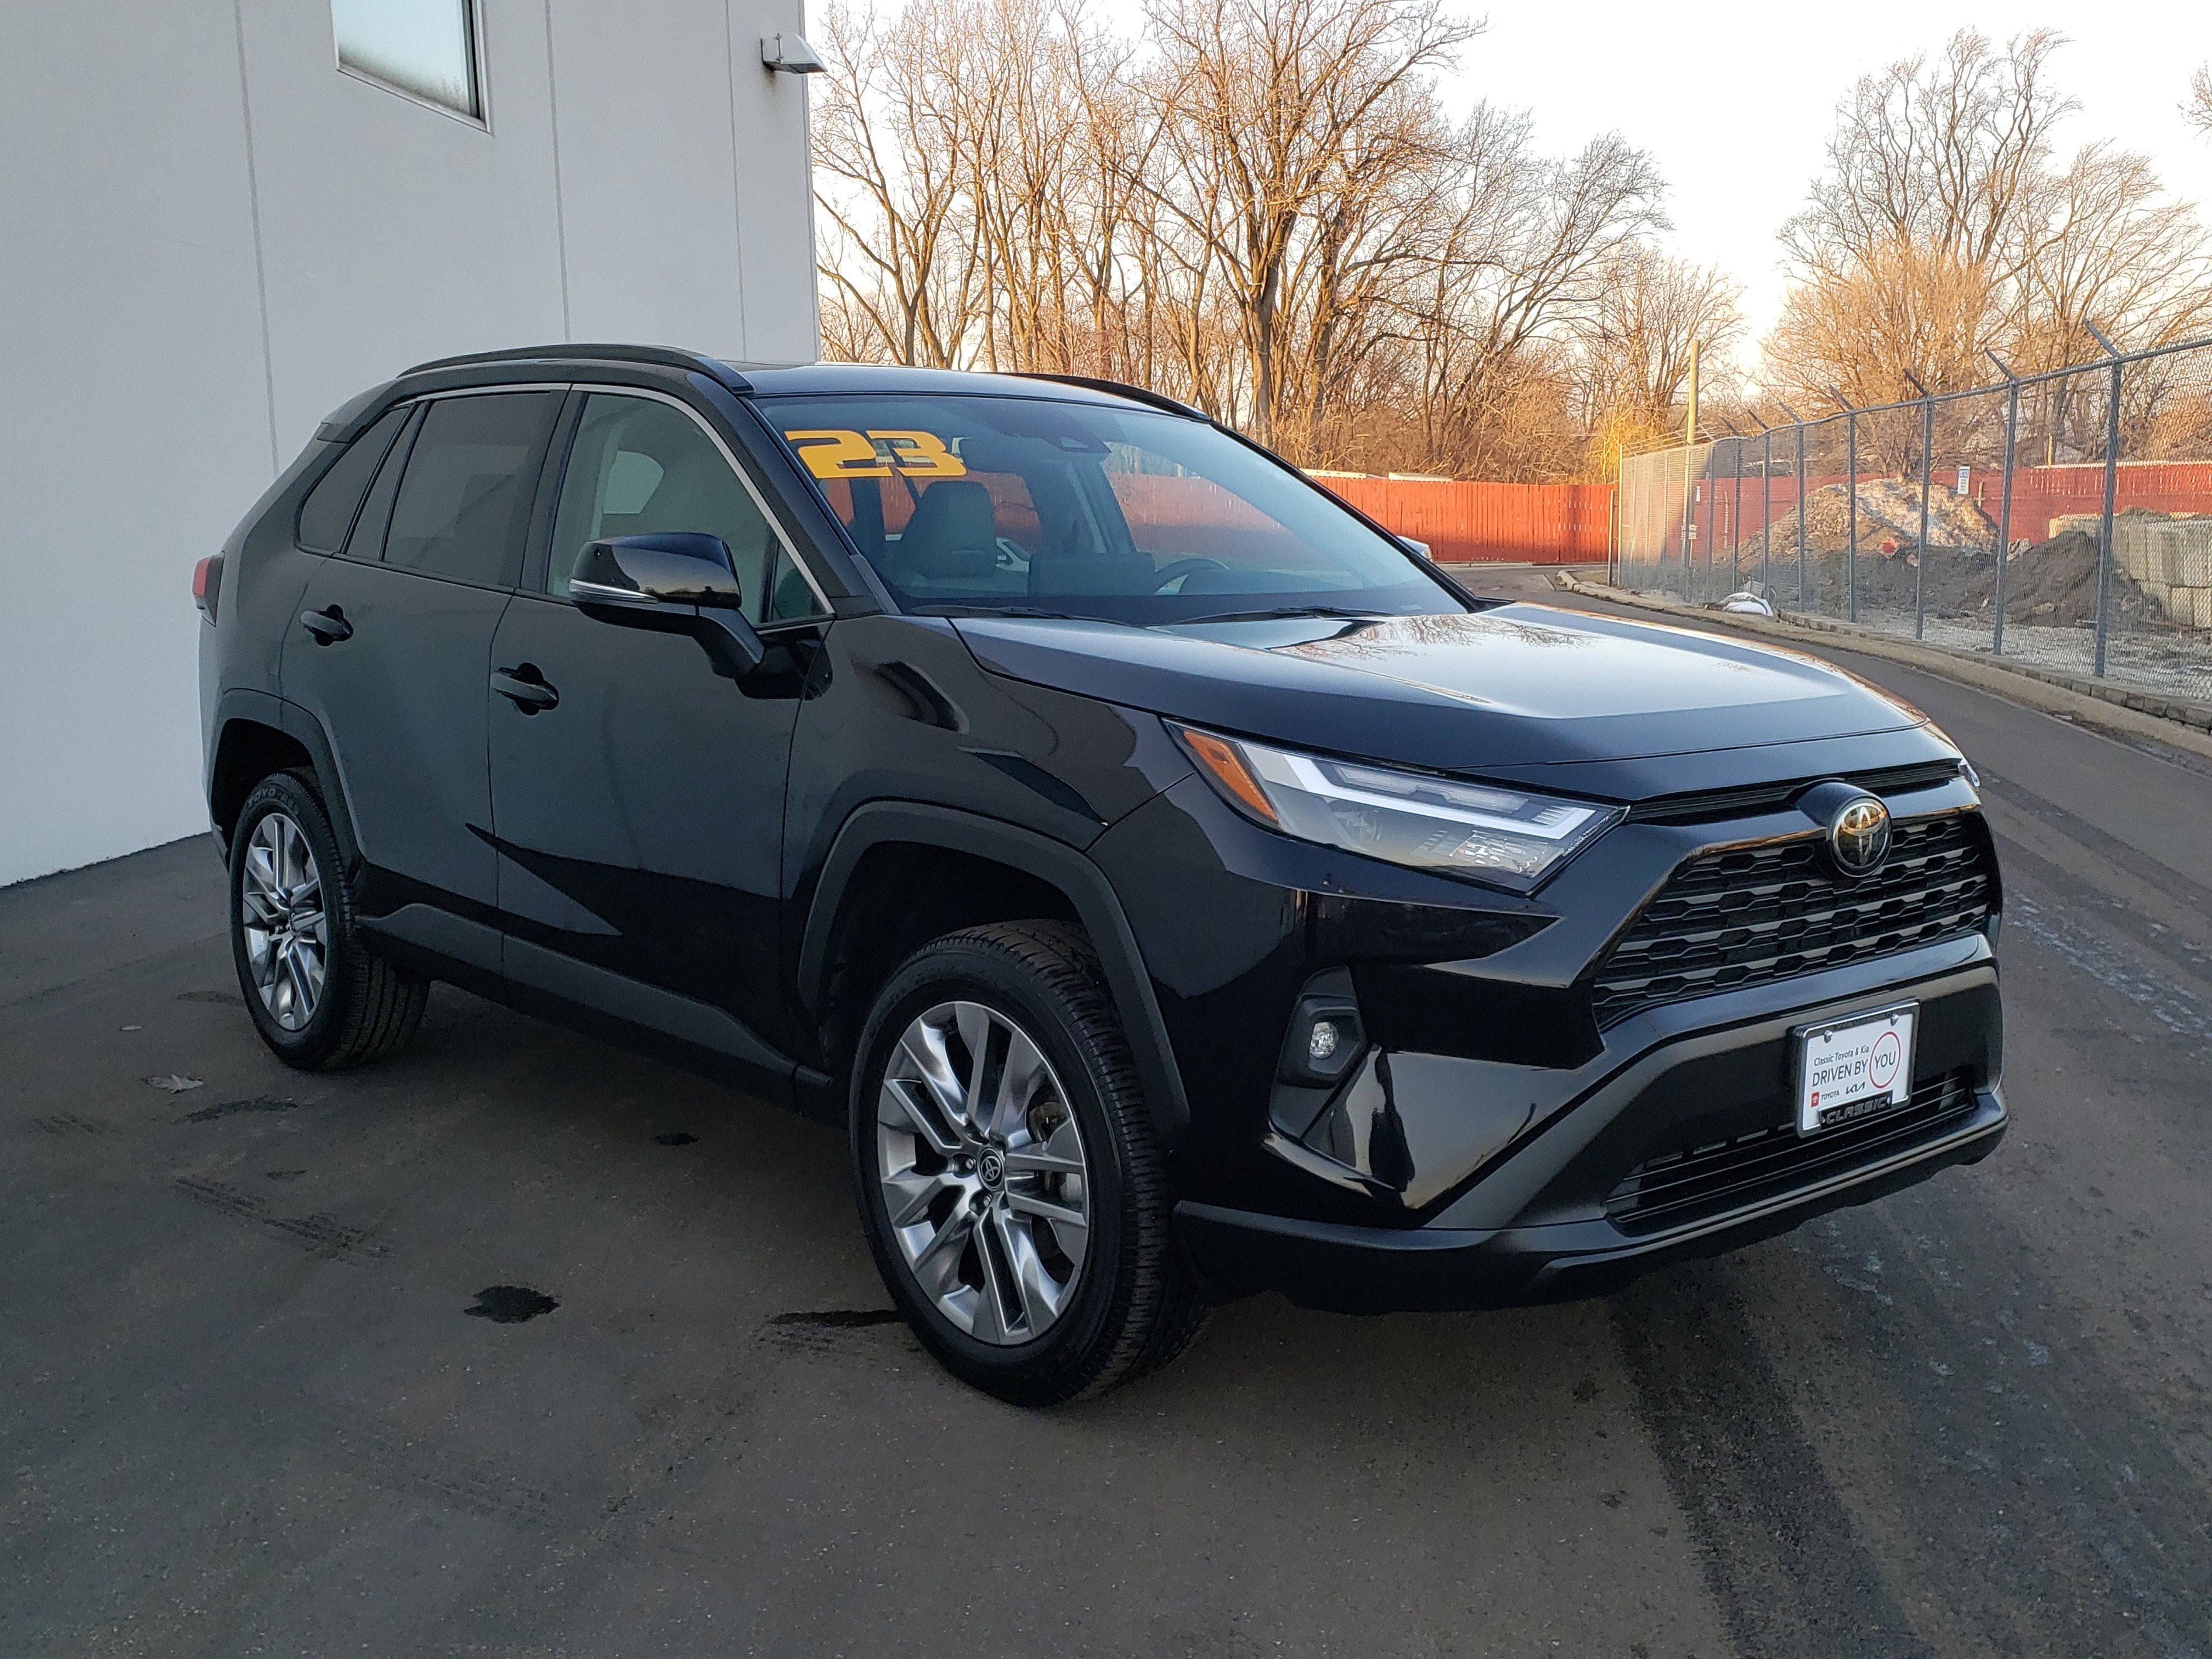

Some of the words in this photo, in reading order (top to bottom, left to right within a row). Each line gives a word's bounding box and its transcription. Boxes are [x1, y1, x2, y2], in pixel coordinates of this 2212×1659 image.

[784, 430, 967, 479] 23
[1812, 1063, 1852, 1087] DRIVEN
[1854, 1058, 1869, 1075] BY
[1874, 1051, 1896, 1070] YOU
[1814, 1054, 1834, 1066] Classic
[1835, 1050, 1854, 1061] Toyota
[1855, 1047, 1859, 1056] &
[1860, 1045, 1870, 1054] Kia
[1821, 1090, 1840, 1101] TOYOTA
[1826, 1096, 1888, 1125] CLASSIC
